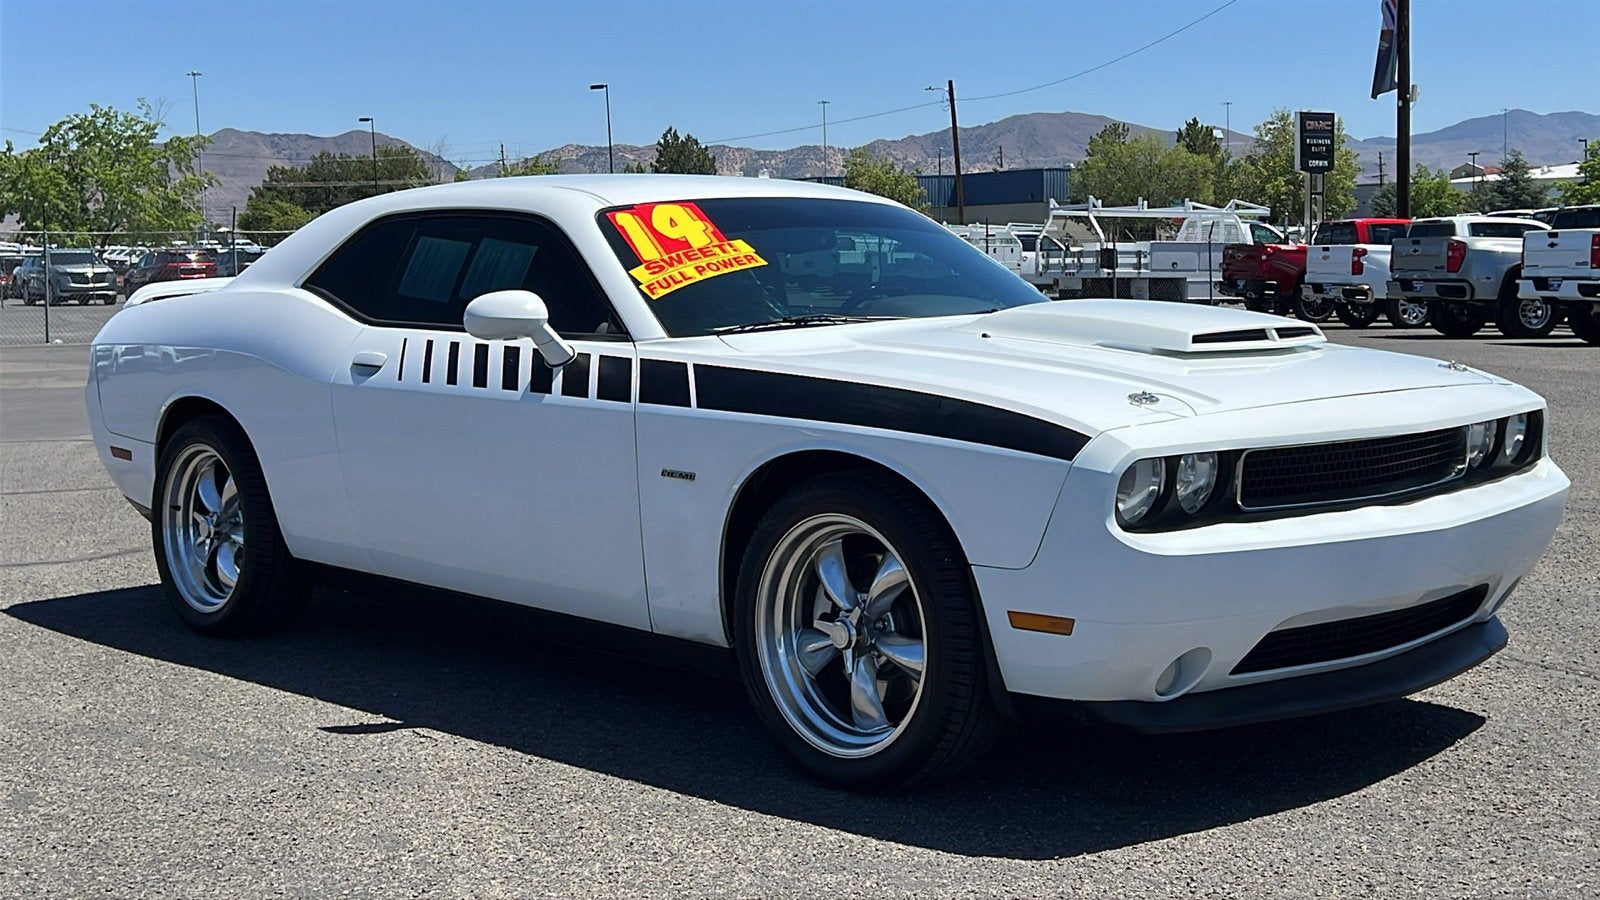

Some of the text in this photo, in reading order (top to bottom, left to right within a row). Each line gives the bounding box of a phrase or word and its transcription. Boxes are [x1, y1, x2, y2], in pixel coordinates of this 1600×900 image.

[1305, 120, 1332, 130] GMC
[615, 203, 712, 261] 14
[644, 242, 738, 275] SWEET!
[645, 254, 759, 296] FULL POWER
